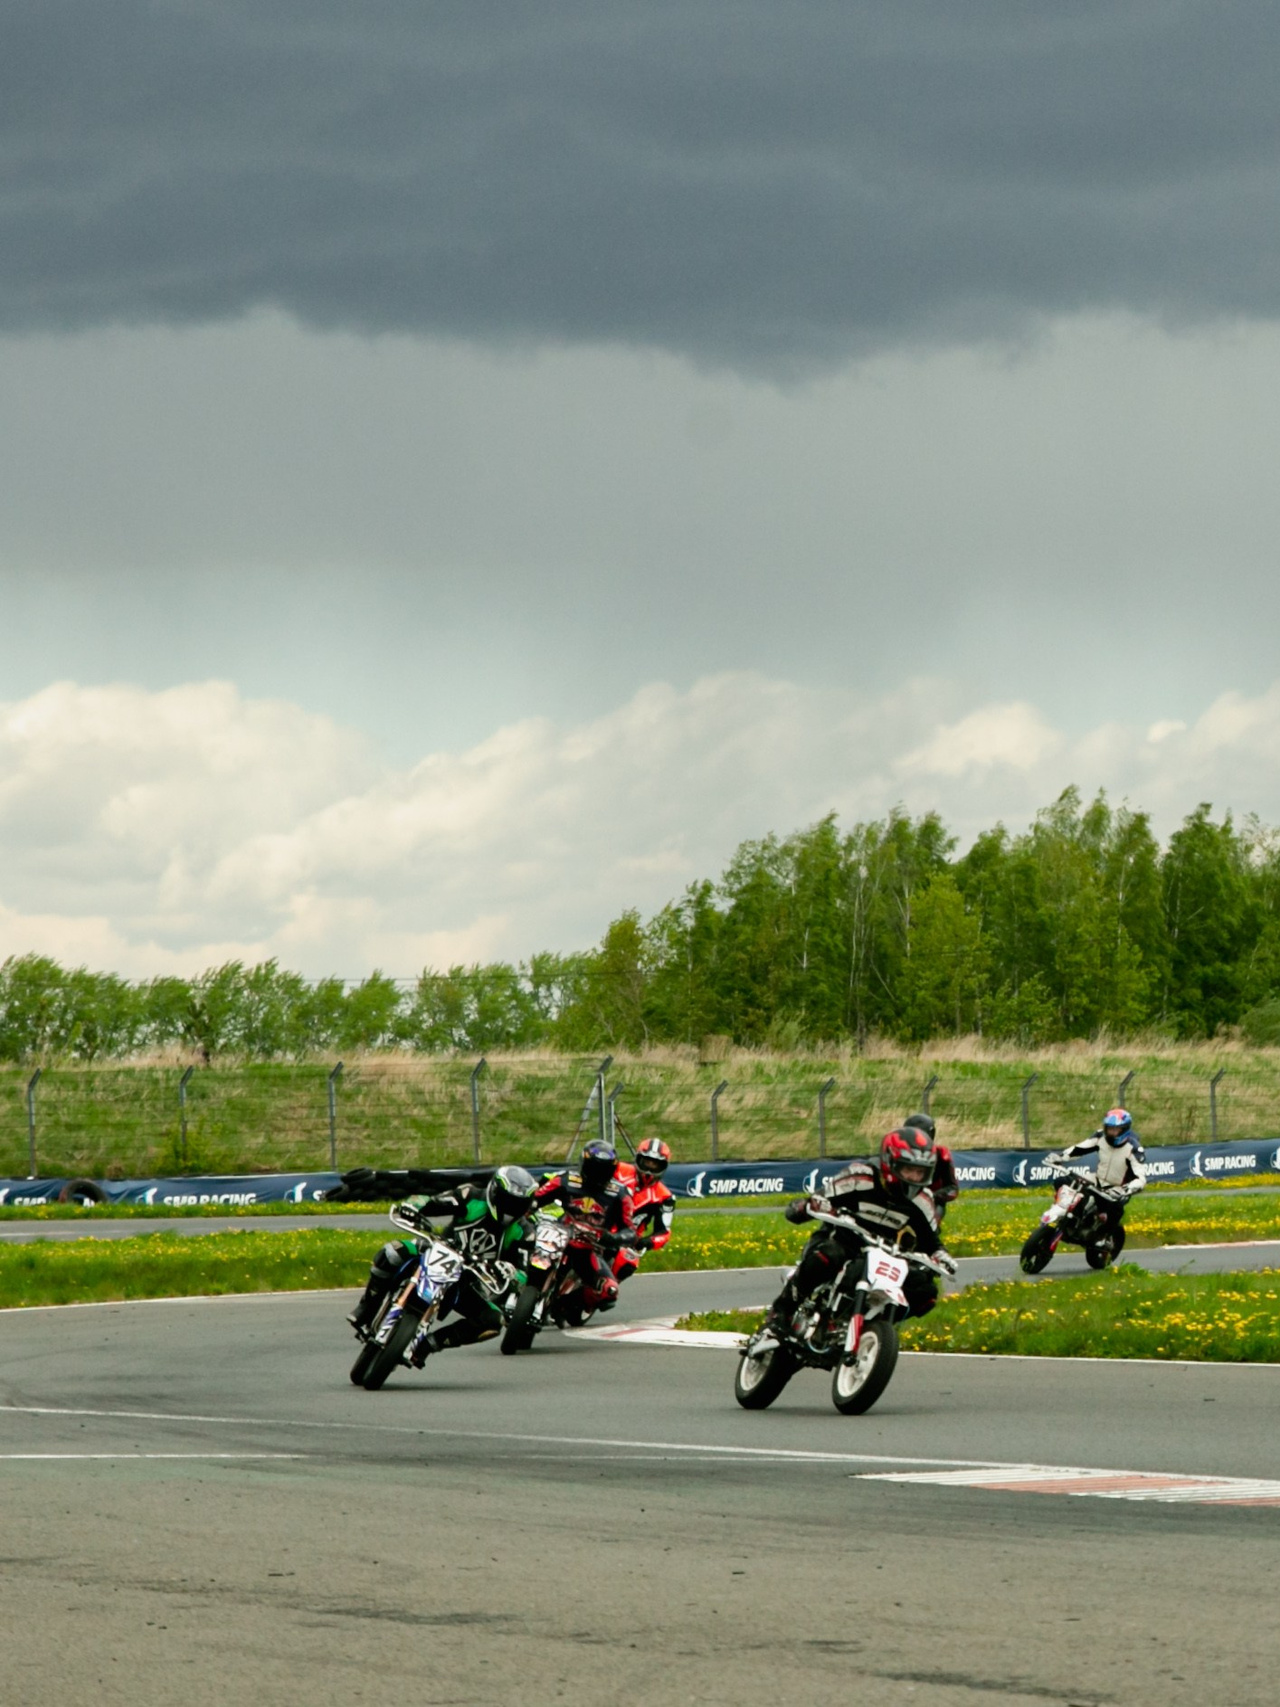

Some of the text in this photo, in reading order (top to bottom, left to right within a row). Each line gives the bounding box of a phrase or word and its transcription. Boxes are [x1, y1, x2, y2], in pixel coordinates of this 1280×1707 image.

[1204, 1155, 1256, 1171] SMP RACING
[954, 1166, 996, 1181] RACING
[1029, 1166, 1053, 1181] SMP
[708, 1177, 784, 1194] SMP RACING
[428, 1250, 458, 1275] 74
[875, 1261, 901, 1282] 23
